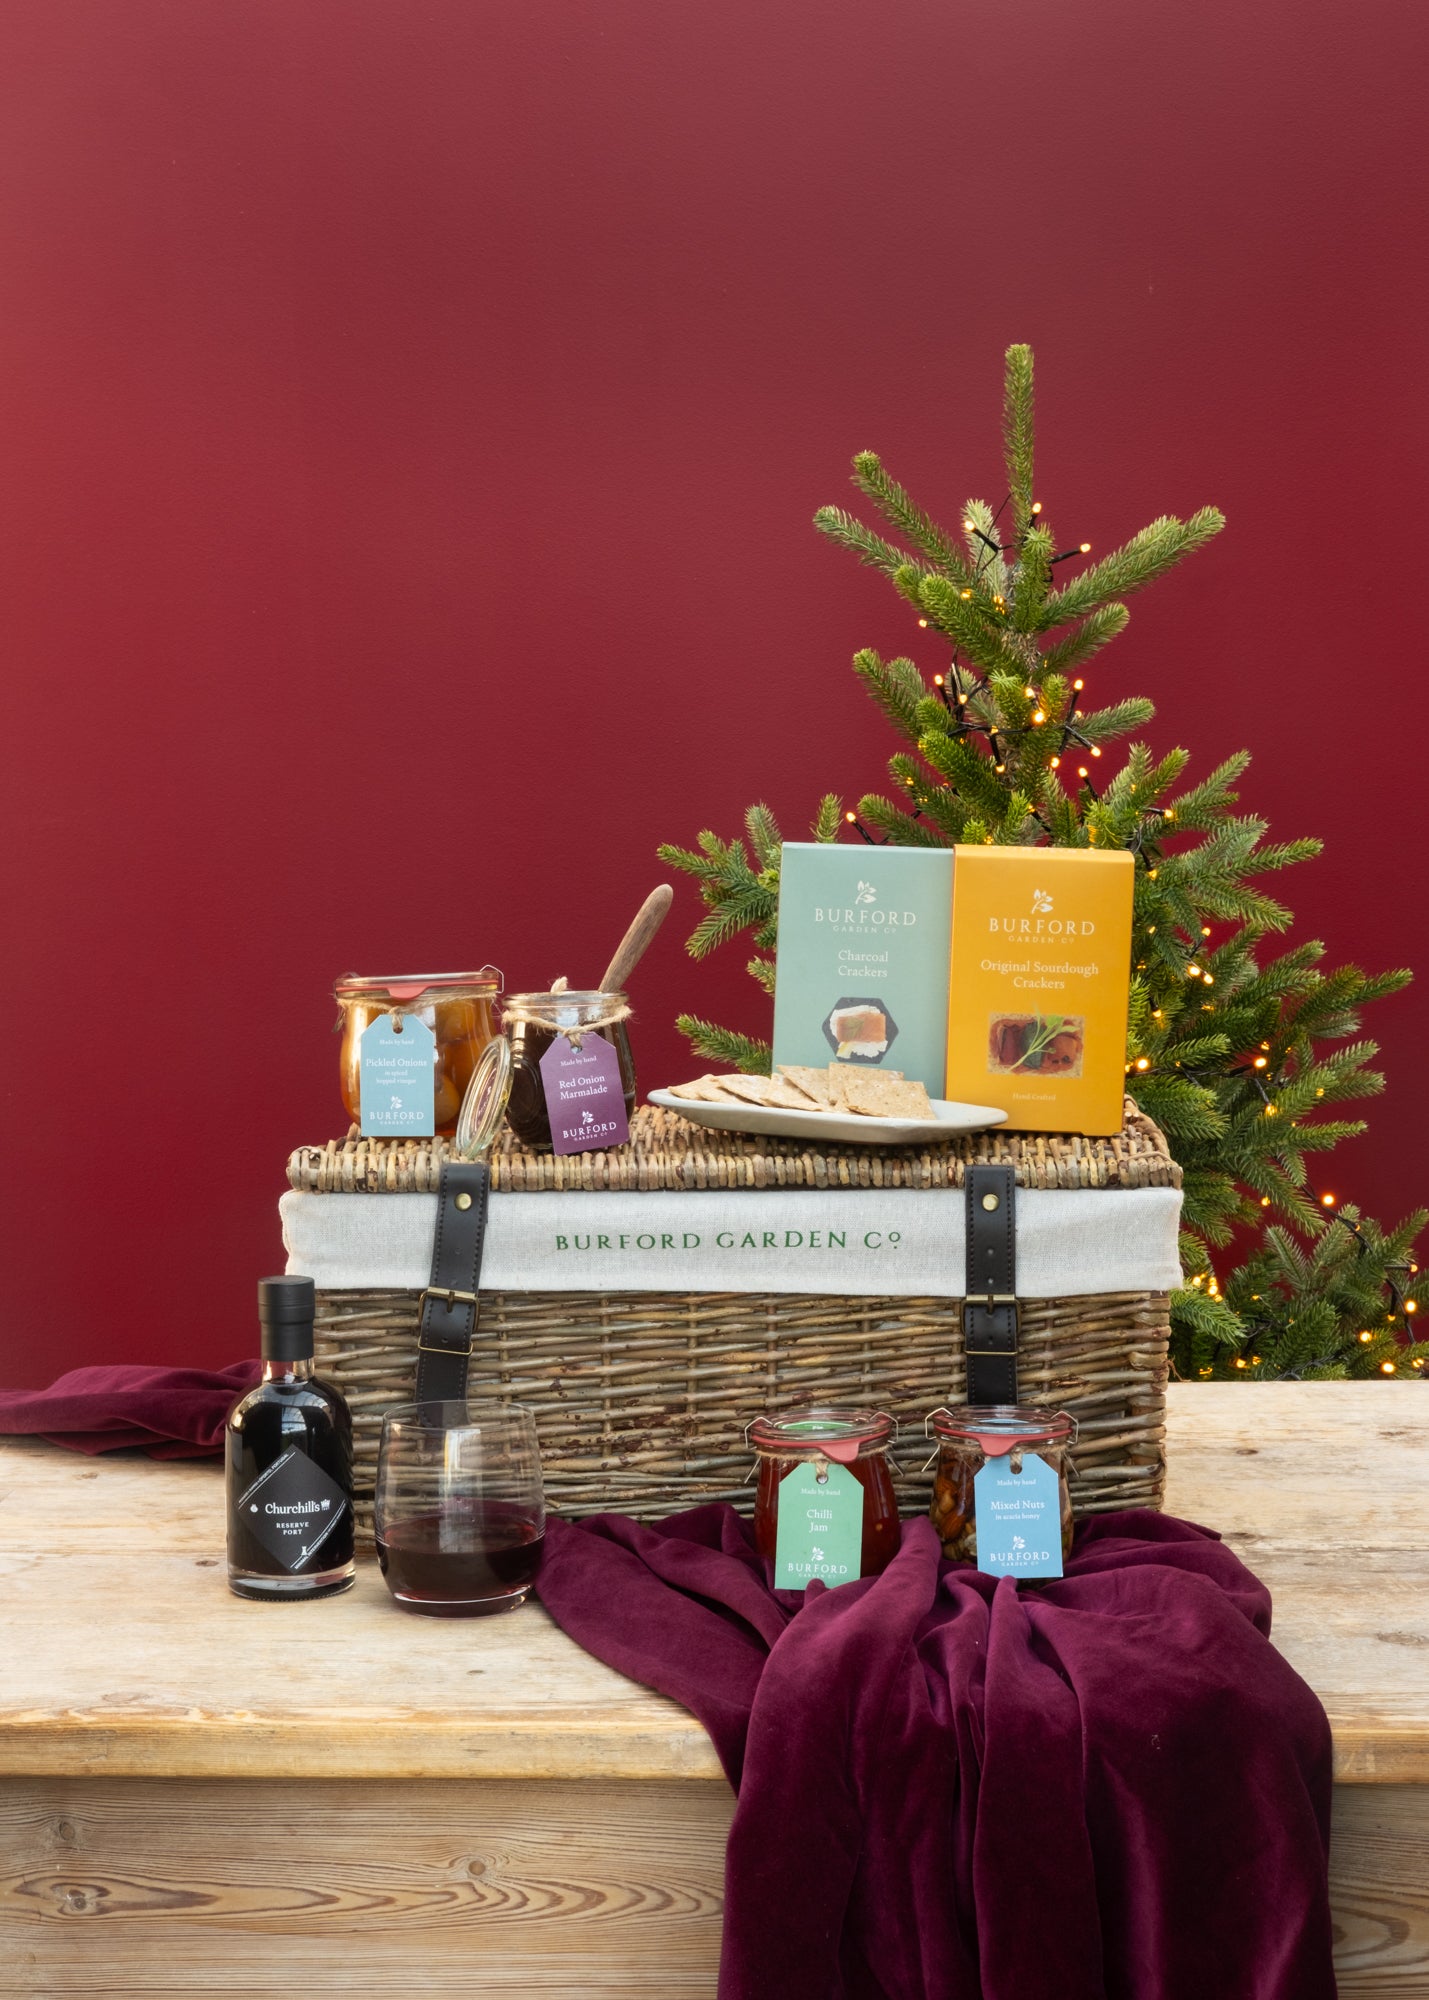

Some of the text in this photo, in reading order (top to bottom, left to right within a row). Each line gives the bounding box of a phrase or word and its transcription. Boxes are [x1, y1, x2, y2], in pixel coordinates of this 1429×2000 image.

[815, 908, 917, 926] BURFORD
[832, 925, 877, 933] GARDEN
[988, 917, 1095, 935] BURFORD
[1008, 935, 1054, 943] GARDEN
[838, 949, 889, 962] Charcoal
[838, 965, 888, 978] Crackers
[980, 959, 1099, 978] Original Sourdough
[1013, 976, 1065, 989] Crackers
[366, 1058, 427, 1067] Pickled Onions
[560, 1059, 575, 1067] Made
[583, 1055, 597, 1063] hand
[559, 1075, 605, 1089] Red Onion
[560, 1085, 608, 1100] Marmalade
[369, 1111, 425, 1120] BURFORD
[563, 1121, 617, 1139] BURFORD
[555, 1232, 701, 1251] BURFORD
[716, 1230, 847, 1249] GARDEN
[1013, 1479, 1021, 1487] by
[817, 1488, 825, 1496] by
[825, 1488, 841, 1496] hand
[265, 1500, 321, 1514] Churchill's
[990, 1500, 1045, 1510] Mixed Nuts
[806, 1509, 833, 1519] Chilli
[1021, 1513, 1040, 1521] honey
[276, 1521, 310, 1529] RESERVE
[808, 1522, 828, 1533] Jam
[989, 1551, 1050, 1562] BURFORD
[787, 1562, 848, 1574] BURFORD
